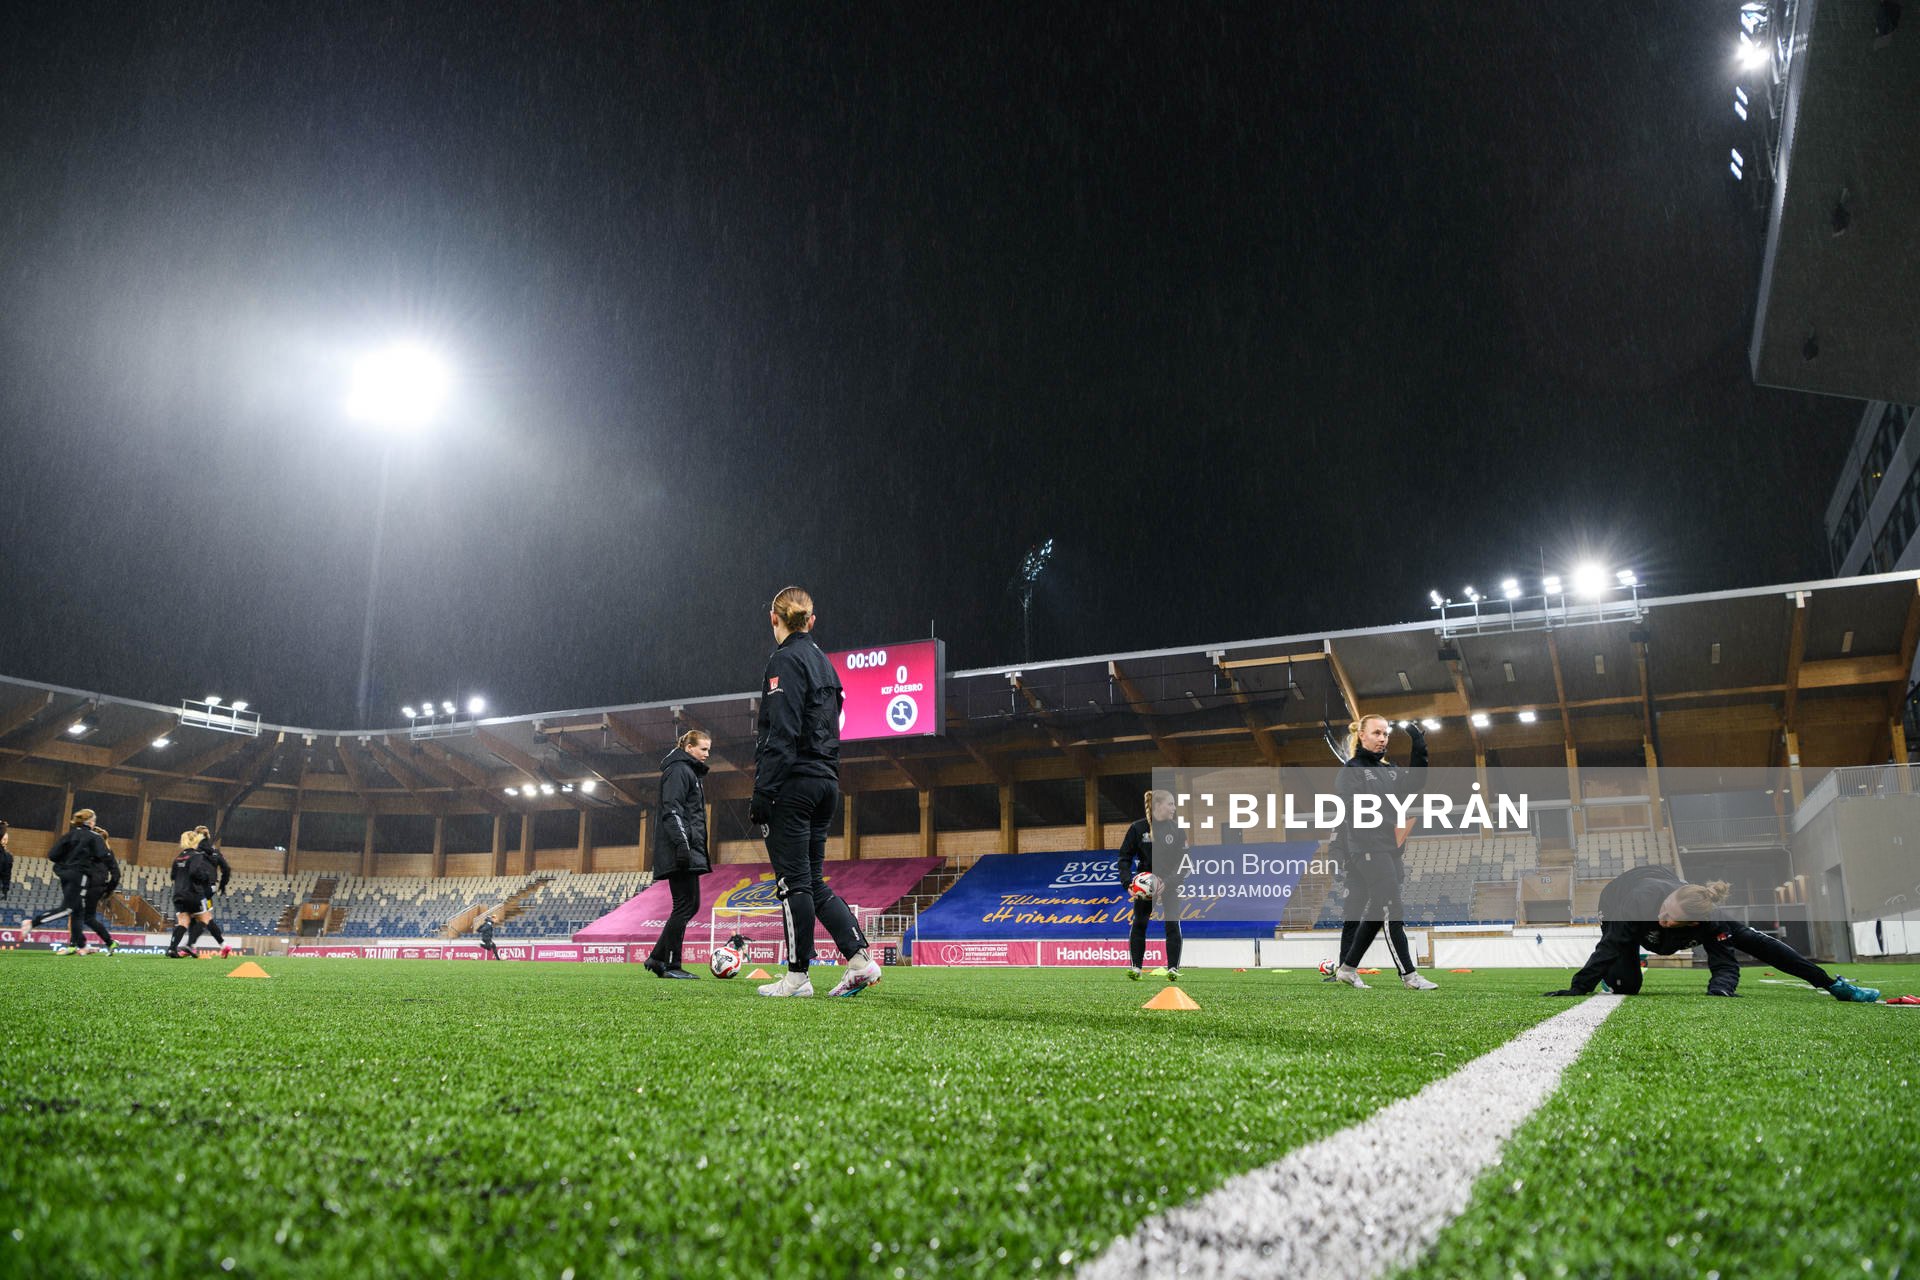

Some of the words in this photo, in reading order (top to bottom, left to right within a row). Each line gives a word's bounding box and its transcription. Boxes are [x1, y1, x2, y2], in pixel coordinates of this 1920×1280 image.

[846, 650, 887, 669] 00:00
[896, 665, 908, 684] 0
[881, 686, 893, 695] KIF
[893, 683, 923, 694] ÖREBRO
[1000, 894, 1123, 905] Tillsammans
[982, 907, 1014, 922] ett
[1015, 909, 1109, 924] vinnande
[583, 945, 625, 954] Larssons
[749, 946, 774, 959] Home
[1056, 947, 1162, 961] Handelsbaen
